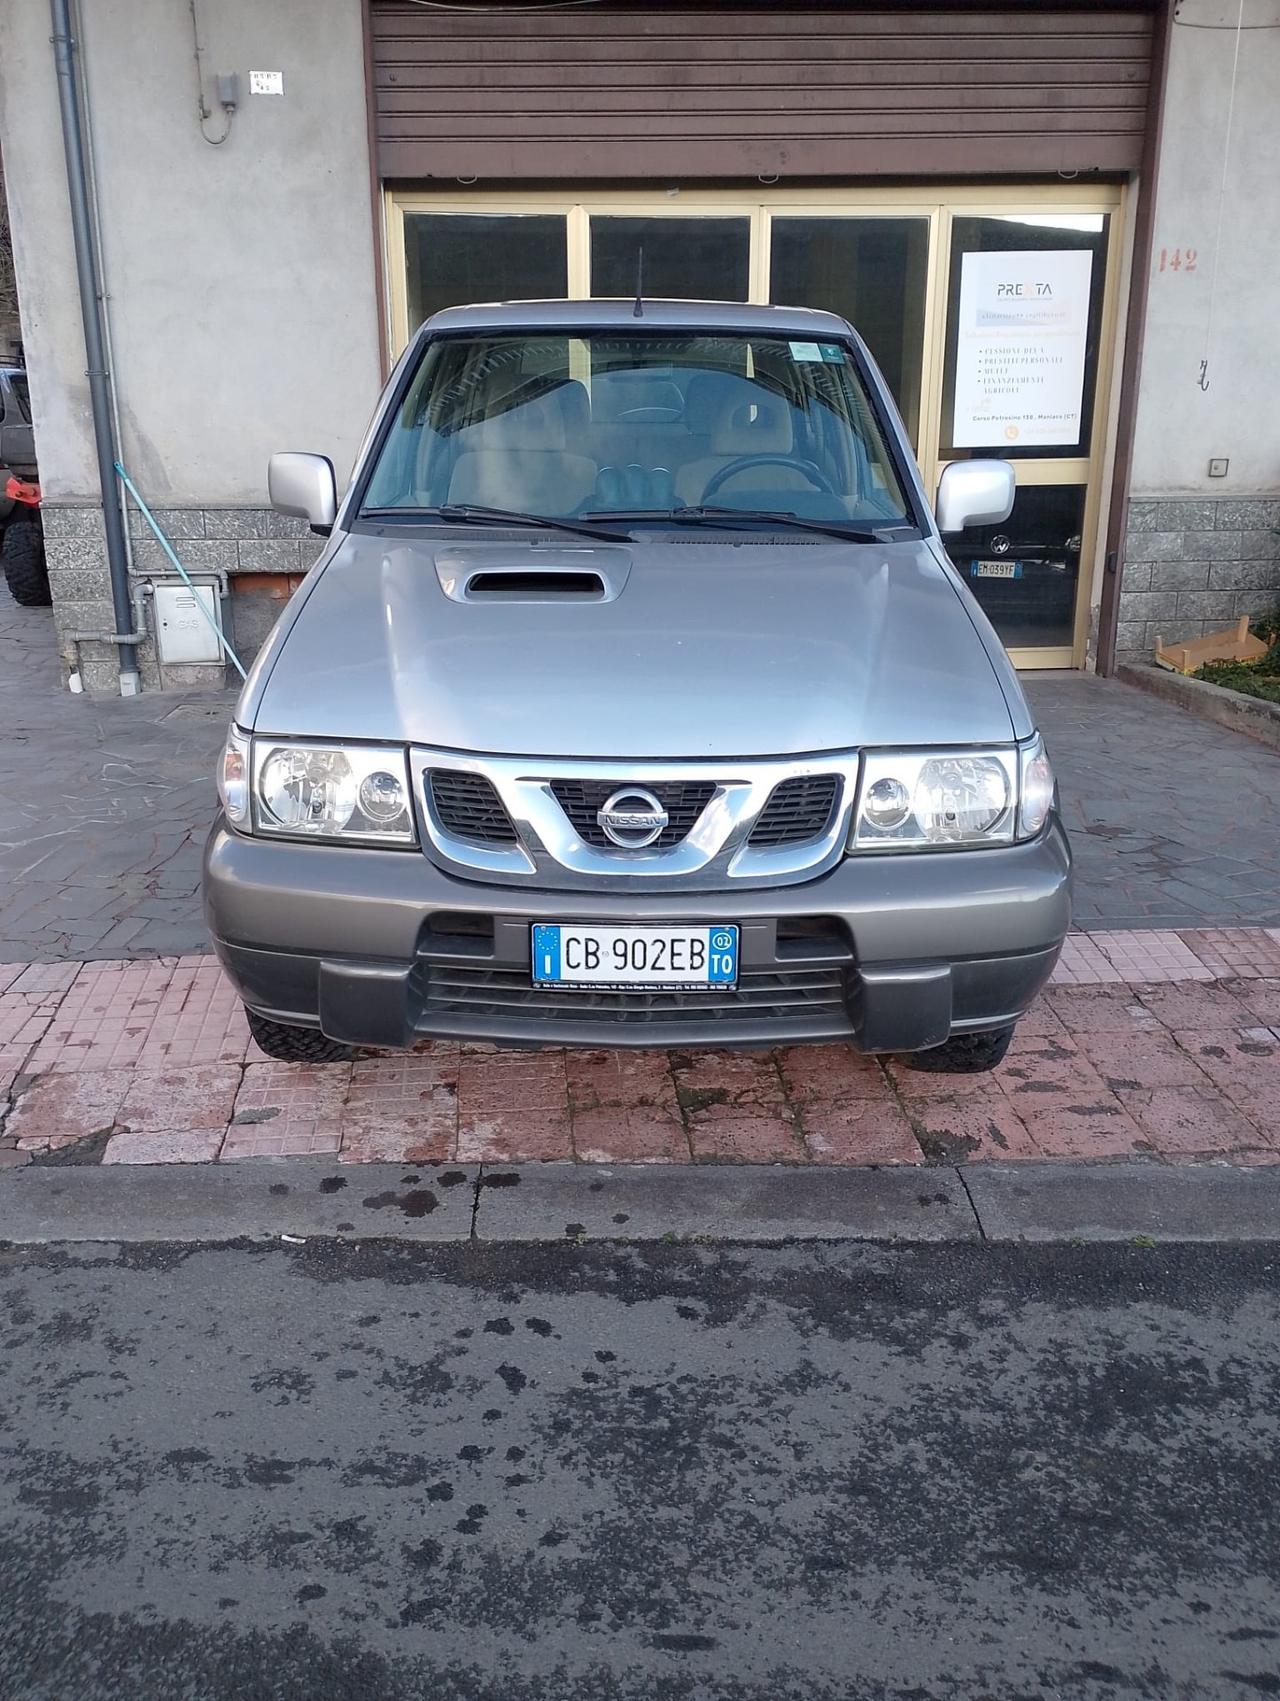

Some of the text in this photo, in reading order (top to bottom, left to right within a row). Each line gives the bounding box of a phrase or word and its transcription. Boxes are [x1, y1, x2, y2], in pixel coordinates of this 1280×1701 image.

[1159, 248, 1198, 272] 142
[997, 283, 1053, 296] PRETA
[605, 815, 661, 826] NISSAN
[565, 937, 600, 970] CB
[612, 938, 706, 971] 902EB
[711, 954, 733, 974] TO
